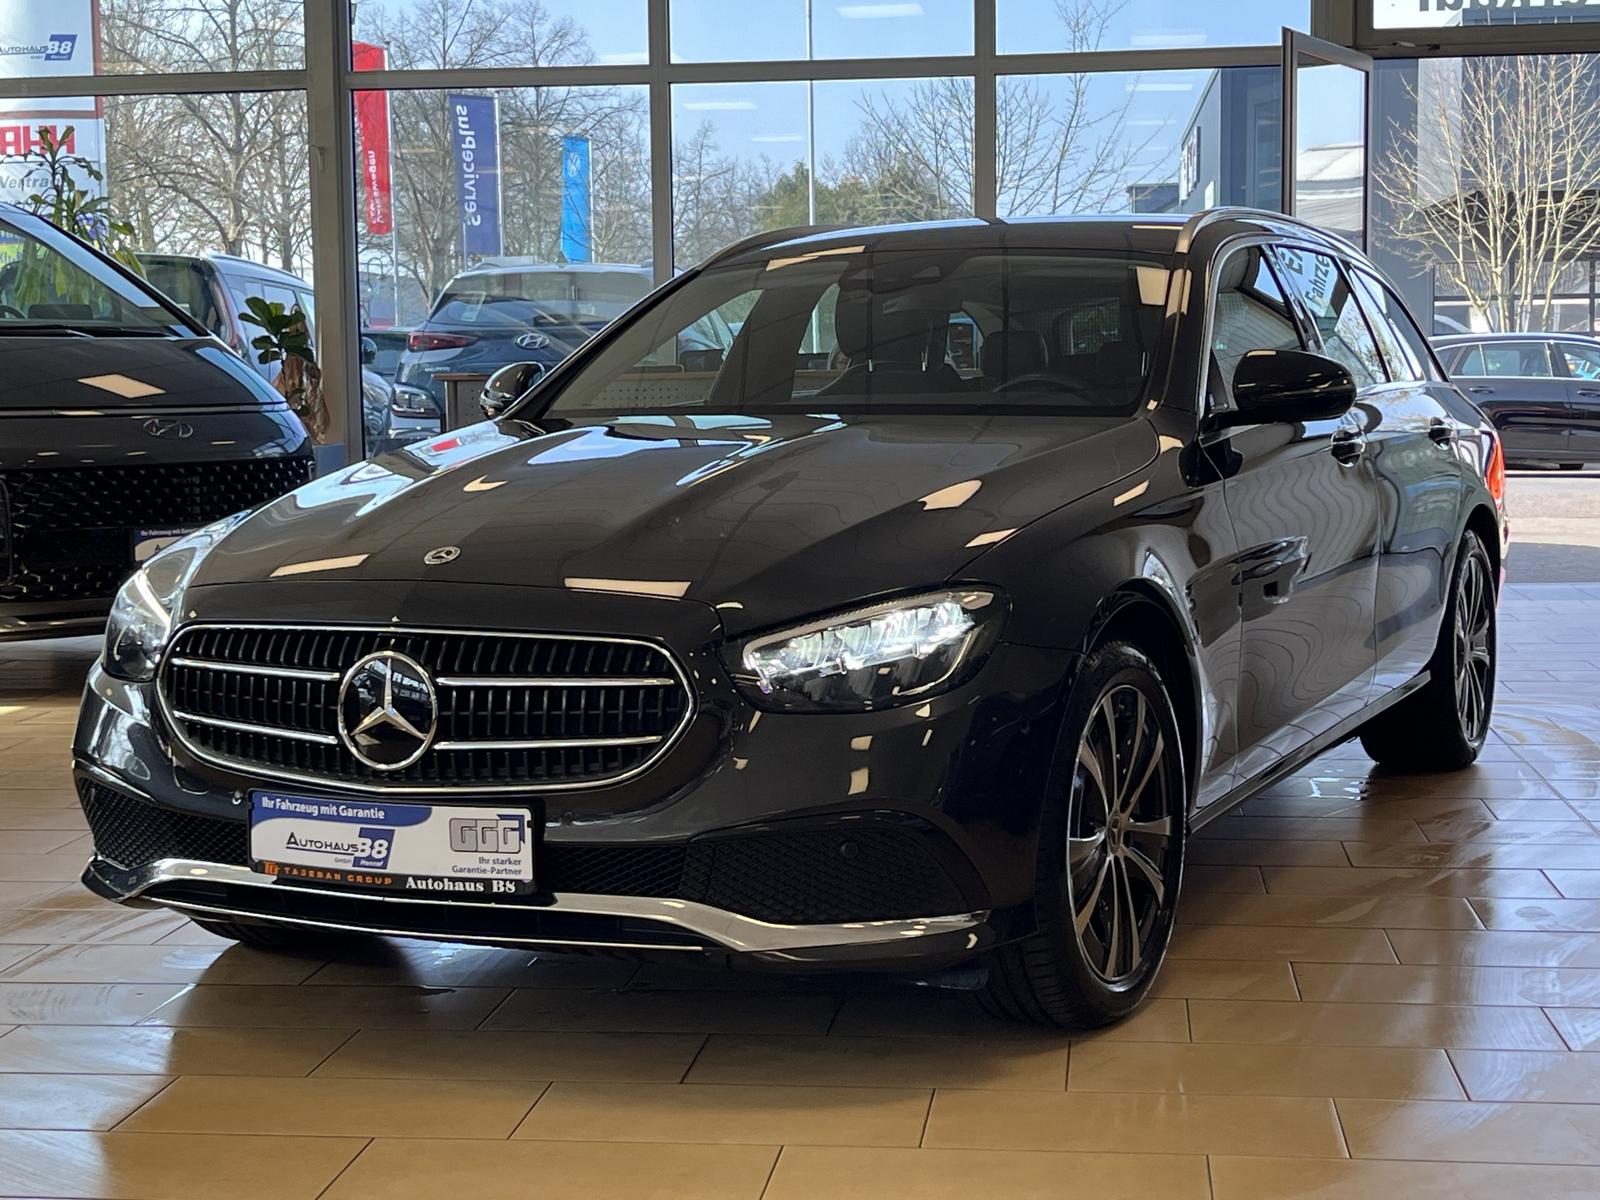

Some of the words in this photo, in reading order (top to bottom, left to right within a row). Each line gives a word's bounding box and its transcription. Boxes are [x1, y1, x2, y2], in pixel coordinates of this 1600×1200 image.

[262, 796, 275, 807] Ihr
[276, 798, 319, 816] Fahrzeug
[320, 803, 337, 815] mit
[339, 805, 385, 819] Garantie
[479, 856, 490, 865] Ihr
[492, 857, 522, 866] starker
[451, 865, 523, 876] Garantie-Partner
[405, 876, 485, 893] Autohaus
[492, 879, 516, 893] B8
